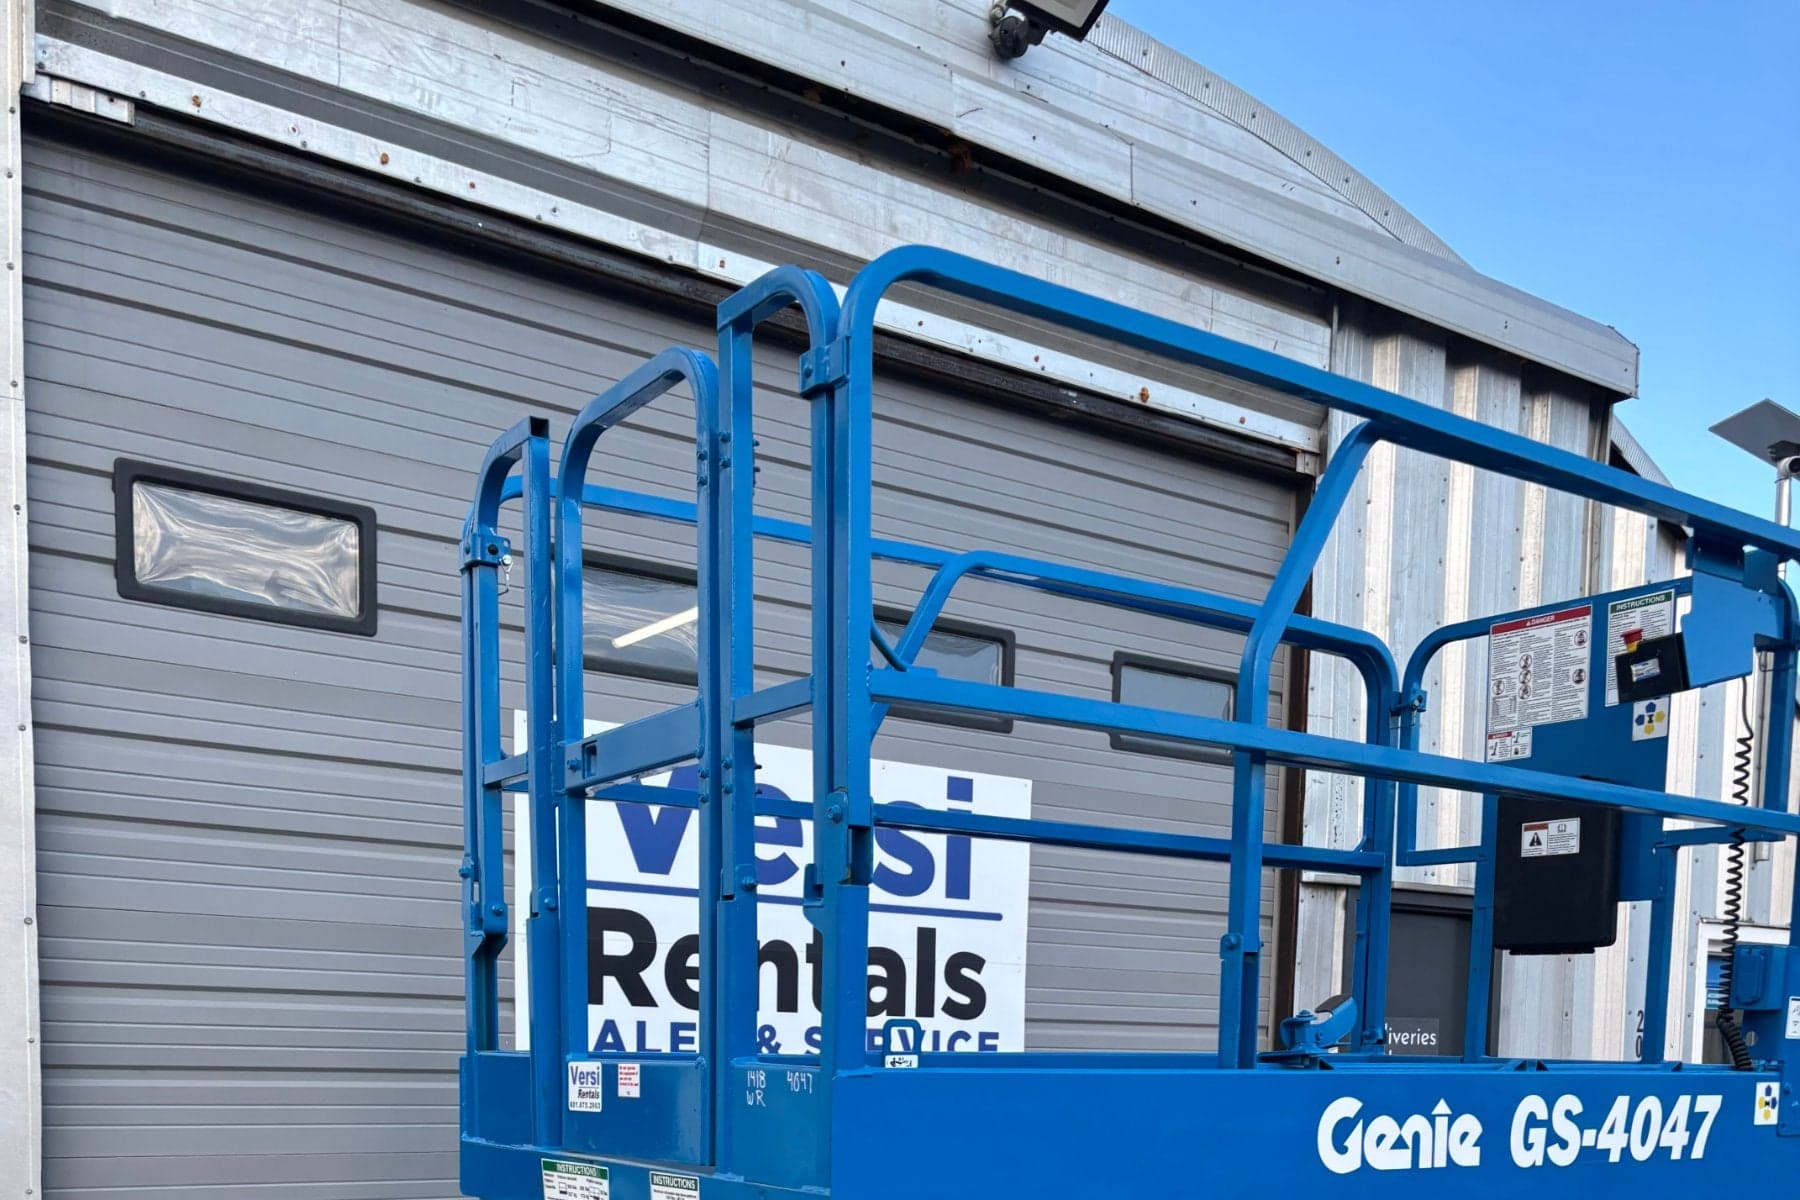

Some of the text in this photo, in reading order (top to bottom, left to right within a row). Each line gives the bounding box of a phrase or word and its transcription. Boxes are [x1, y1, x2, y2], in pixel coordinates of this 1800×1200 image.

[612, 764, 974, 901] Vesi
[593, 1019, 697, 1053] ALE
[570, 1066, 600, 1086] Versi
[578, 1089, 600, 1099] Rentals
[1317, 1094, 1723, 1174] Genie GS-4047
[556, 1163, 597, 1177] INSTRUCTIONS
[653, 1175, 695, 1189] INSTRUCTIONS
